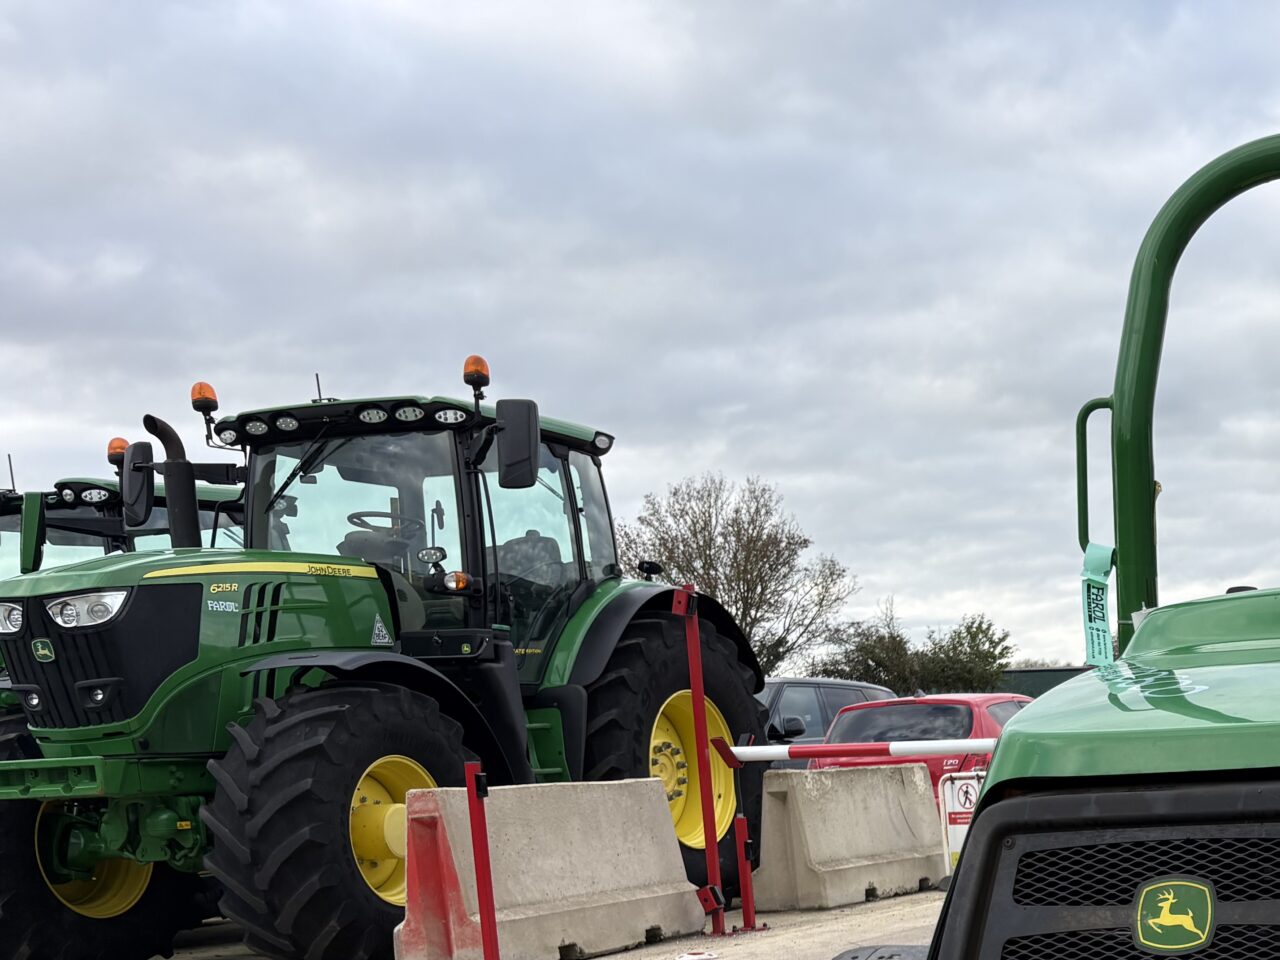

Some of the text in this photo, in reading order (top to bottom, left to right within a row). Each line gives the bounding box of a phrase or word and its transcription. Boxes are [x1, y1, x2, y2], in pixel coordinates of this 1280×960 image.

[209, 583, 239, 593] 6215R
[207, 600, 239, 613] FAROL
[1091, 584, 1106, 624] FAROL
